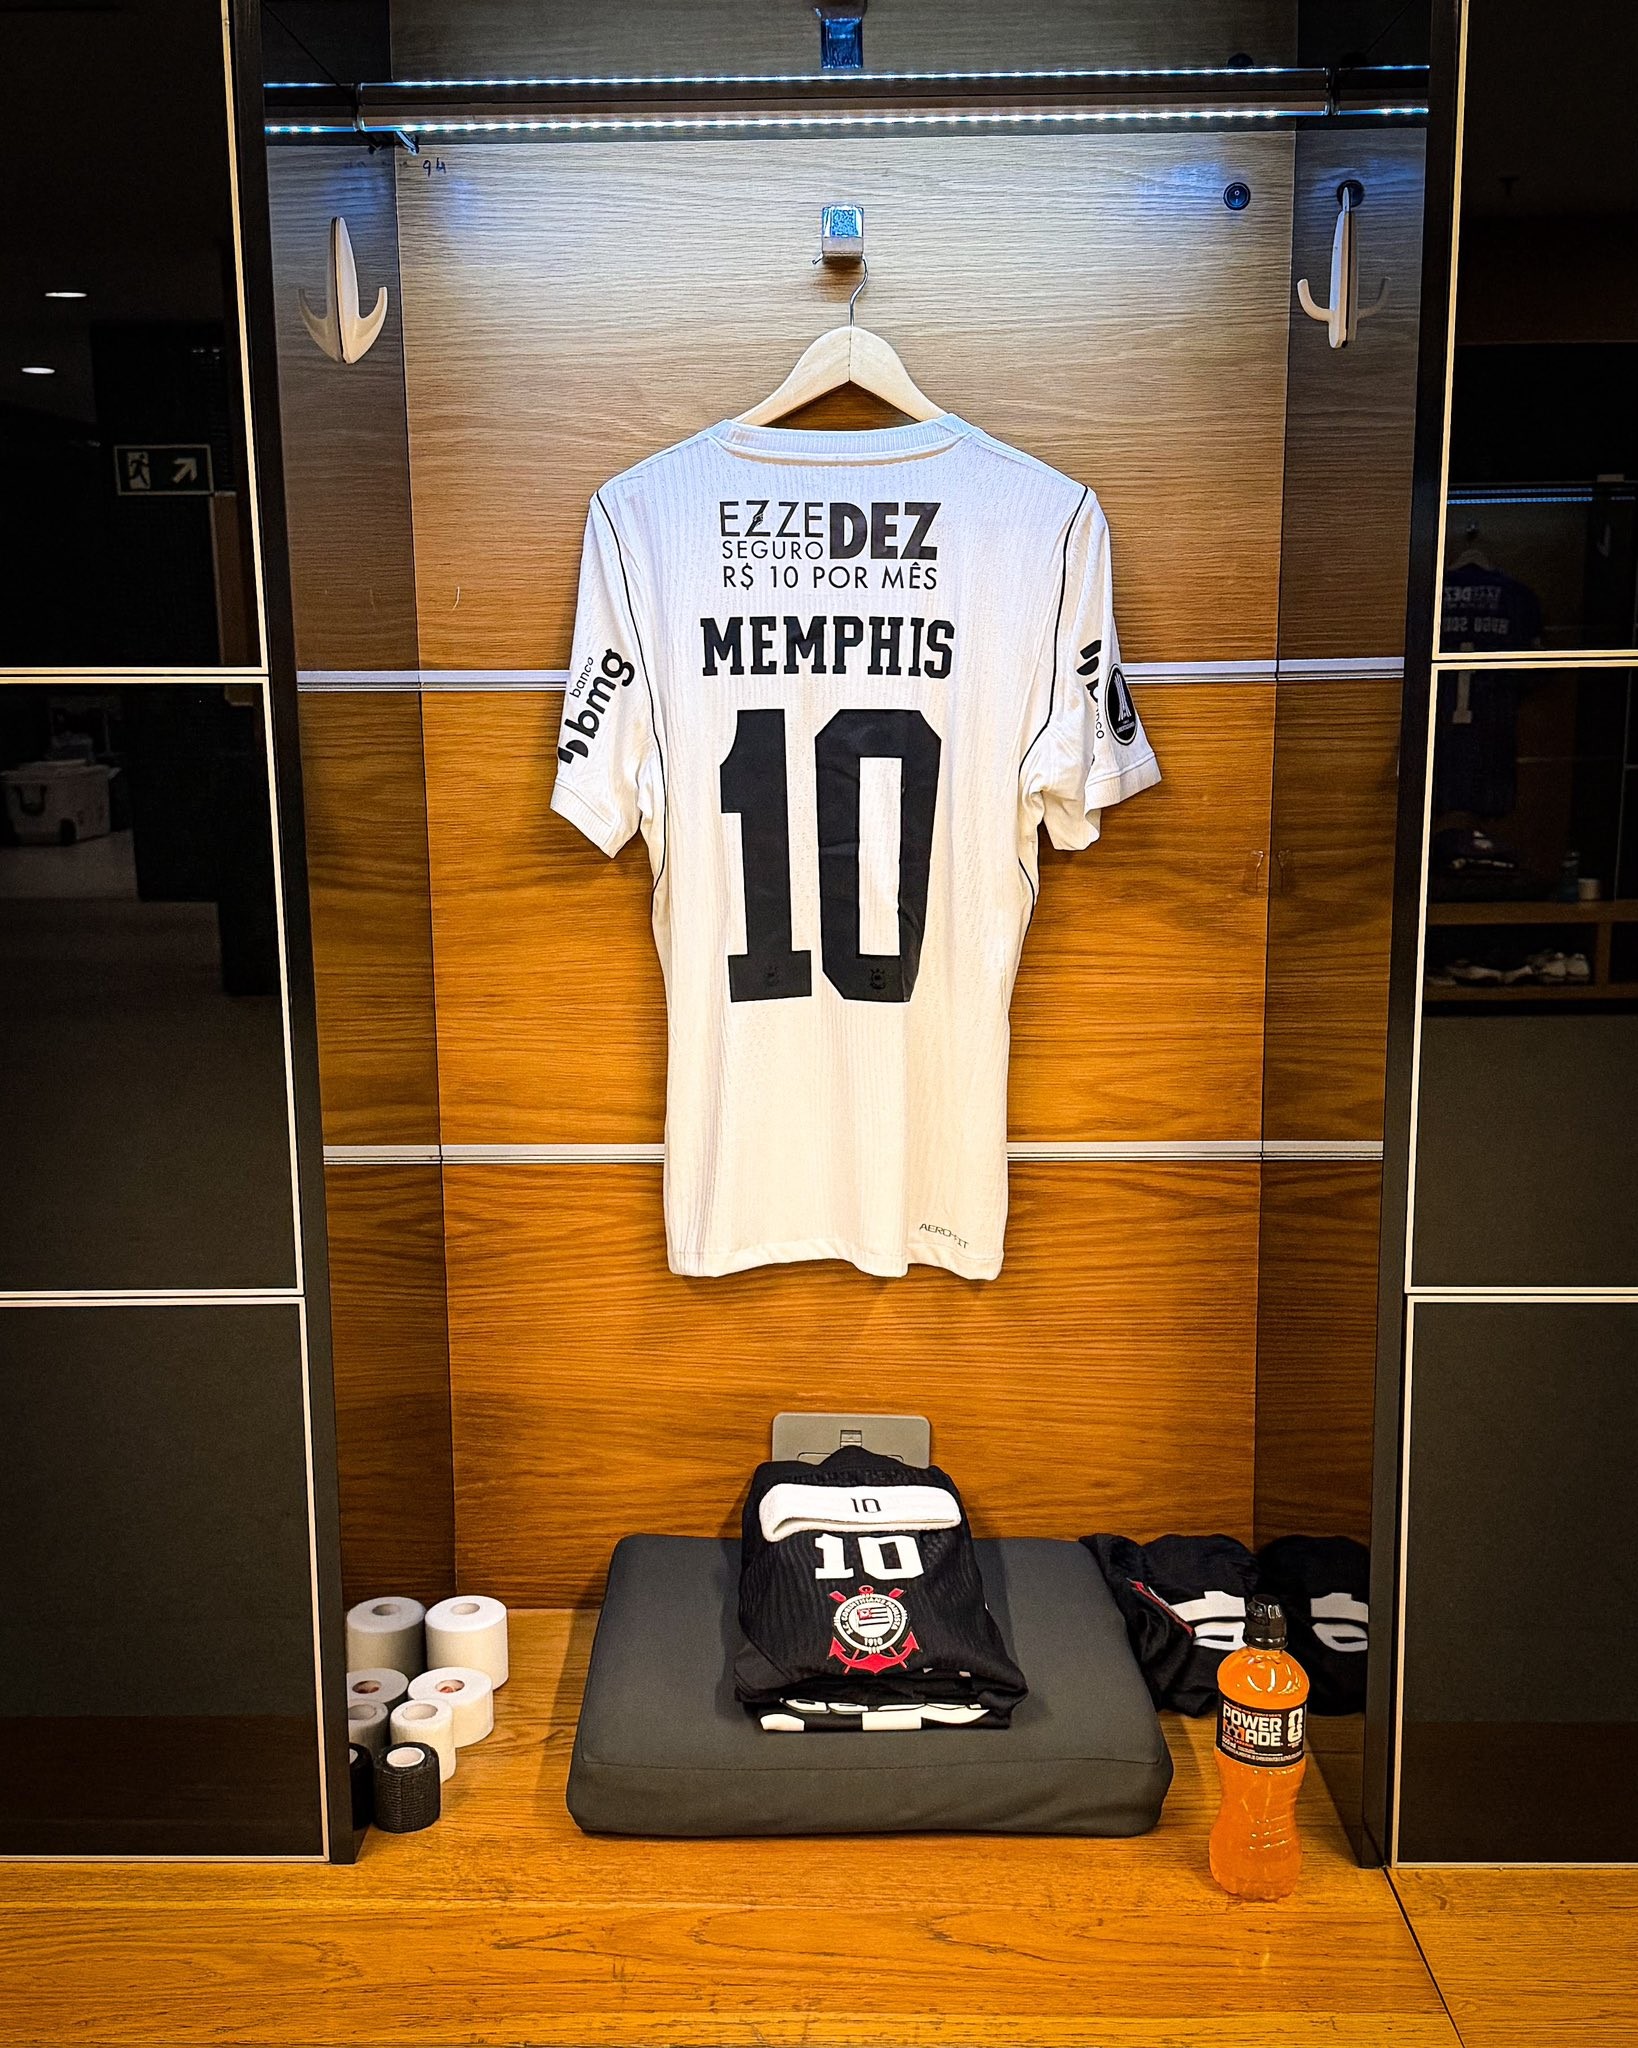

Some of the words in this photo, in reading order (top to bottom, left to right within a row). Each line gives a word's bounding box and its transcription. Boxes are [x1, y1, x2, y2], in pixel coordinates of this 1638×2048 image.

[423, 157, 446, 177] 94
[829, 502, 941, 560] DEZ
[722, 540, 823, 560] SEGURO
[723, 562, 754, 590] R$
[770, 565, 799, 588] 10
[813, 565, 868, 589] POR
[882, 562, 937, 590] MÊS
[700, 616, 955, 679] MEMPHIS
[569, 656, 594, 698] banco
[563, 648, 635, 739] bmg
[719, 708, 942, 1003] 10
[850, 1498, 882, 1514] 10
[815, 1533, 925, 1580] 10
[864, 1637, 883, 1647] 1910
[1223, 1703, 1282, 1732] POWER
[1245, 1729, 1282, 1747] ADE
